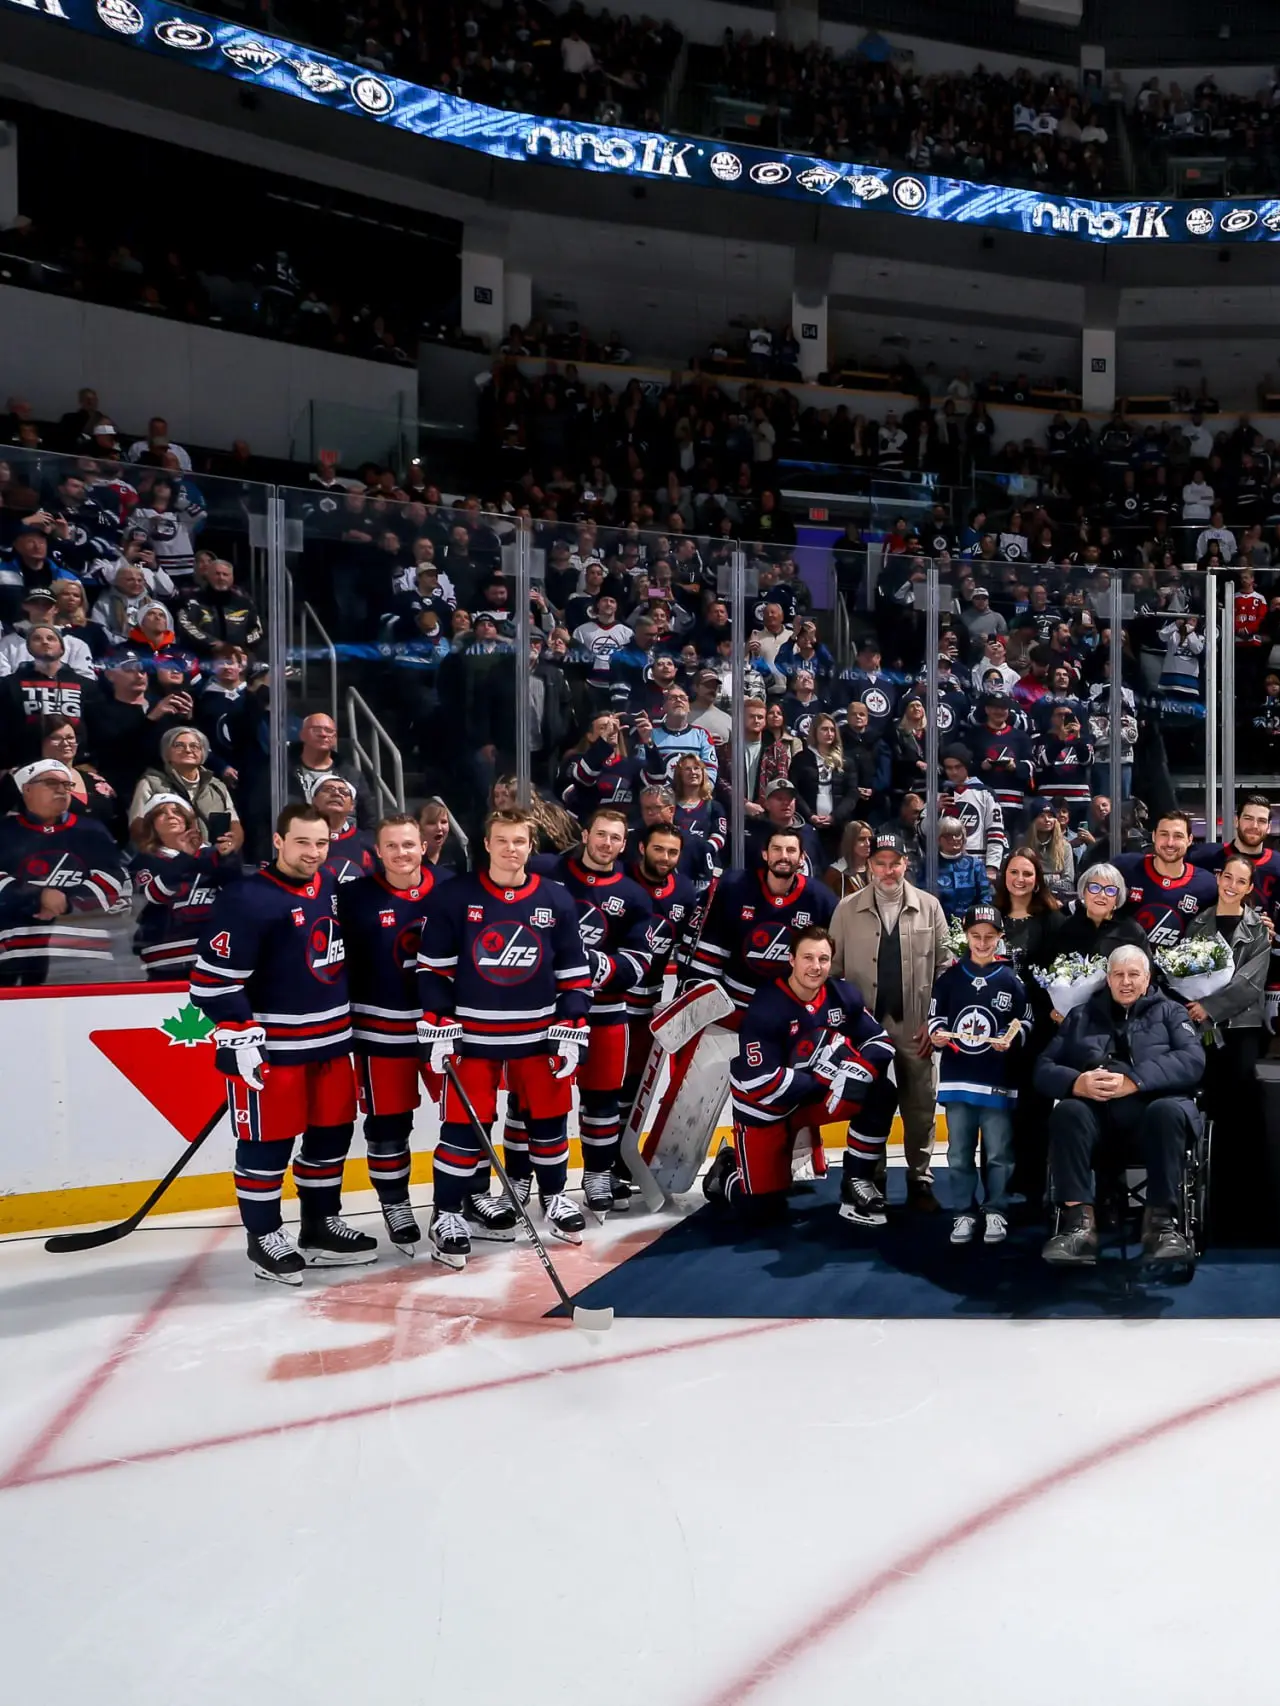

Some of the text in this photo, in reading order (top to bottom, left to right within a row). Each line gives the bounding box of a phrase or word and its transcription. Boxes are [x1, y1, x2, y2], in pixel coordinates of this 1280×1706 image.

[637, 136, 695, 179] 1K
[1122, 205, 1174, 239] 1K
[22, 687, 81, 702] THE
[24, 700, 81, 718] PEG
[28, 853, 84, 887] JETS
[173, 873, 216, 909] JETS
[210, 931, 231, 958] 4
[312, 919, 345, 969] JETS
[478, 924, 538, 967] JETS
[218, 1033, 264, 1047] CCM
[550, 1028, 588, 1041] WARRI
[747, 1042, 763, 1067] 5
